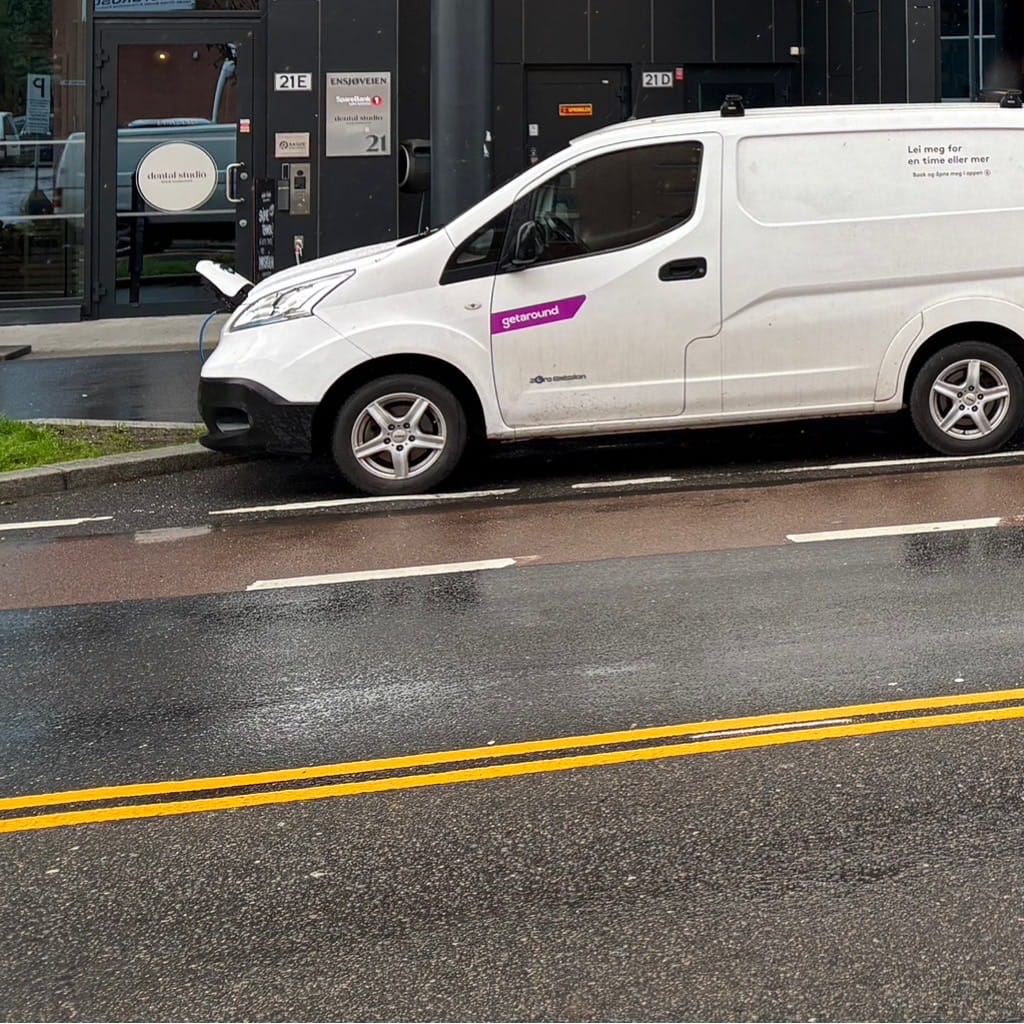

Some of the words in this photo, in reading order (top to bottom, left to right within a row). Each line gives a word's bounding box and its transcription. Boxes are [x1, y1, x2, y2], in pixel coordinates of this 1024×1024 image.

[330, 77, 388, 86] ENSJØVEIEN
[365, 134, 387, 152] 21
[907, 145, 922, 154] Lei
[924, 146, 945, 155] meg
[947, 144, 963, 153] for
[922, 156, 946, 165] time
[947, 155, 969, 165] eller
[971, 156, 990, 164] mer
[147, 171, 177, 180] dental
[178, 170, 207, 179] studio
[502, 305, 560, 329] getaround
